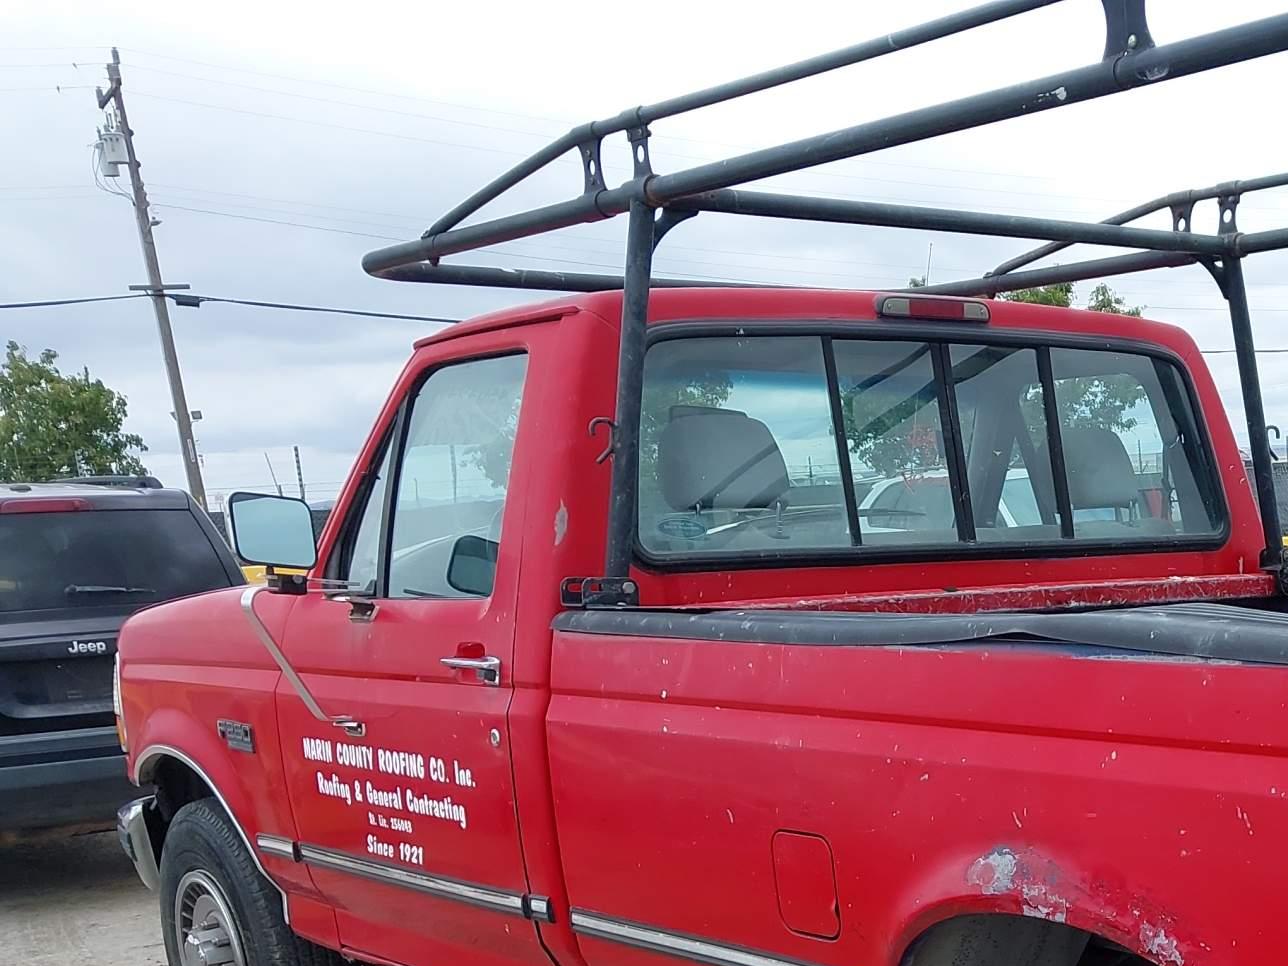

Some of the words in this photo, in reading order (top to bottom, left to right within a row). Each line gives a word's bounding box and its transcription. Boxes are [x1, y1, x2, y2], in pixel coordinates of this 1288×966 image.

[67, 640, 106, 654] Jeep
[302, 737, 332, 763] MARIN
[336, 742, 374, 770] COUNTY
[378, 748, 424, 780] ROOFING
[429, 757, 449, 783] CO.
[453, 760, 476, 787] Inc.
[316, 772, 351, 805] Roofing
[354, 780, 363, 802] &
[366, 781, 403, 810] General
[406, 789, 467, 829] Contracting
[367, 833, 394, 858] Since
[399, 842, 423, 865] 1921
